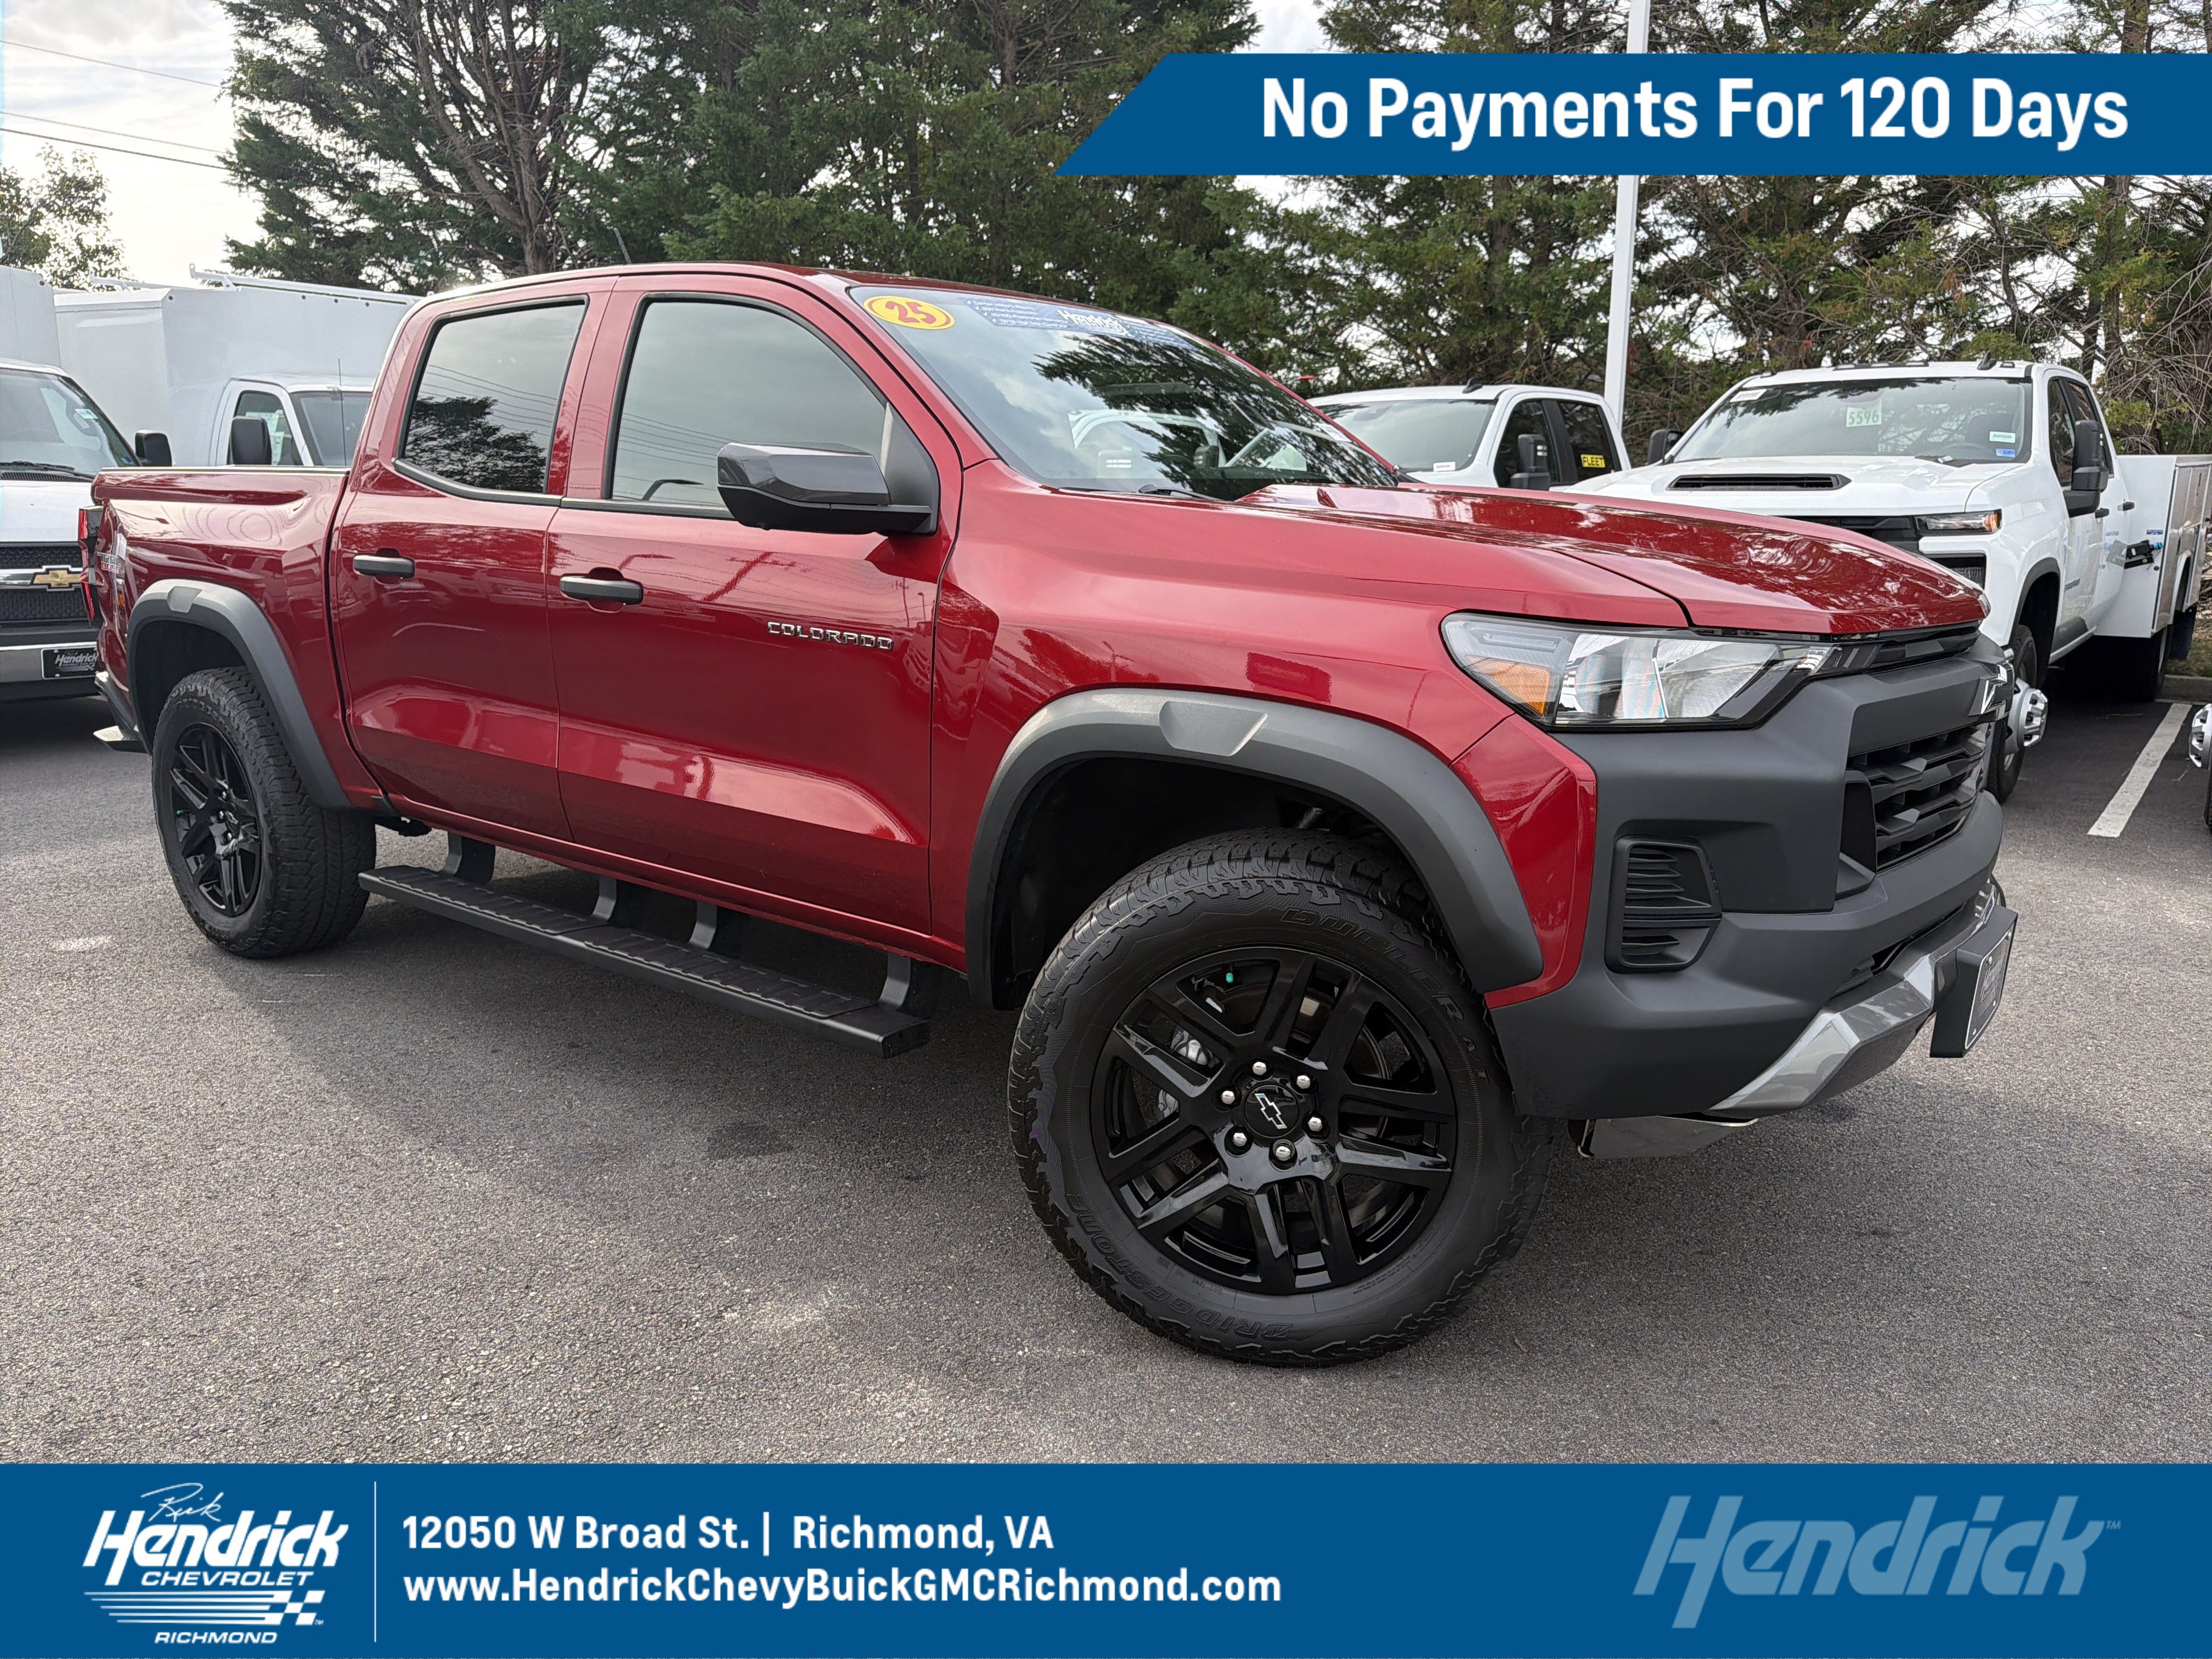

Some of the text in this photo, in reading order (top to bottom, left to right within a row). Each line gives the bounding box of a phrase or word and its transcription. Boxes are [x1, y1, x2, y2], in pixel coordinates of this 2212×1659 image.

[885, 301, 936, 324] 25
[1848, 410, 1880, 425] 5596
[1582, 456, 1603, 466] FLEET
[768, 622, 893, 650] COLORADO
[55, 652, 98, 667] Hendrick
[1067, 1194, 1294, 1340] BRIDGESTONE
